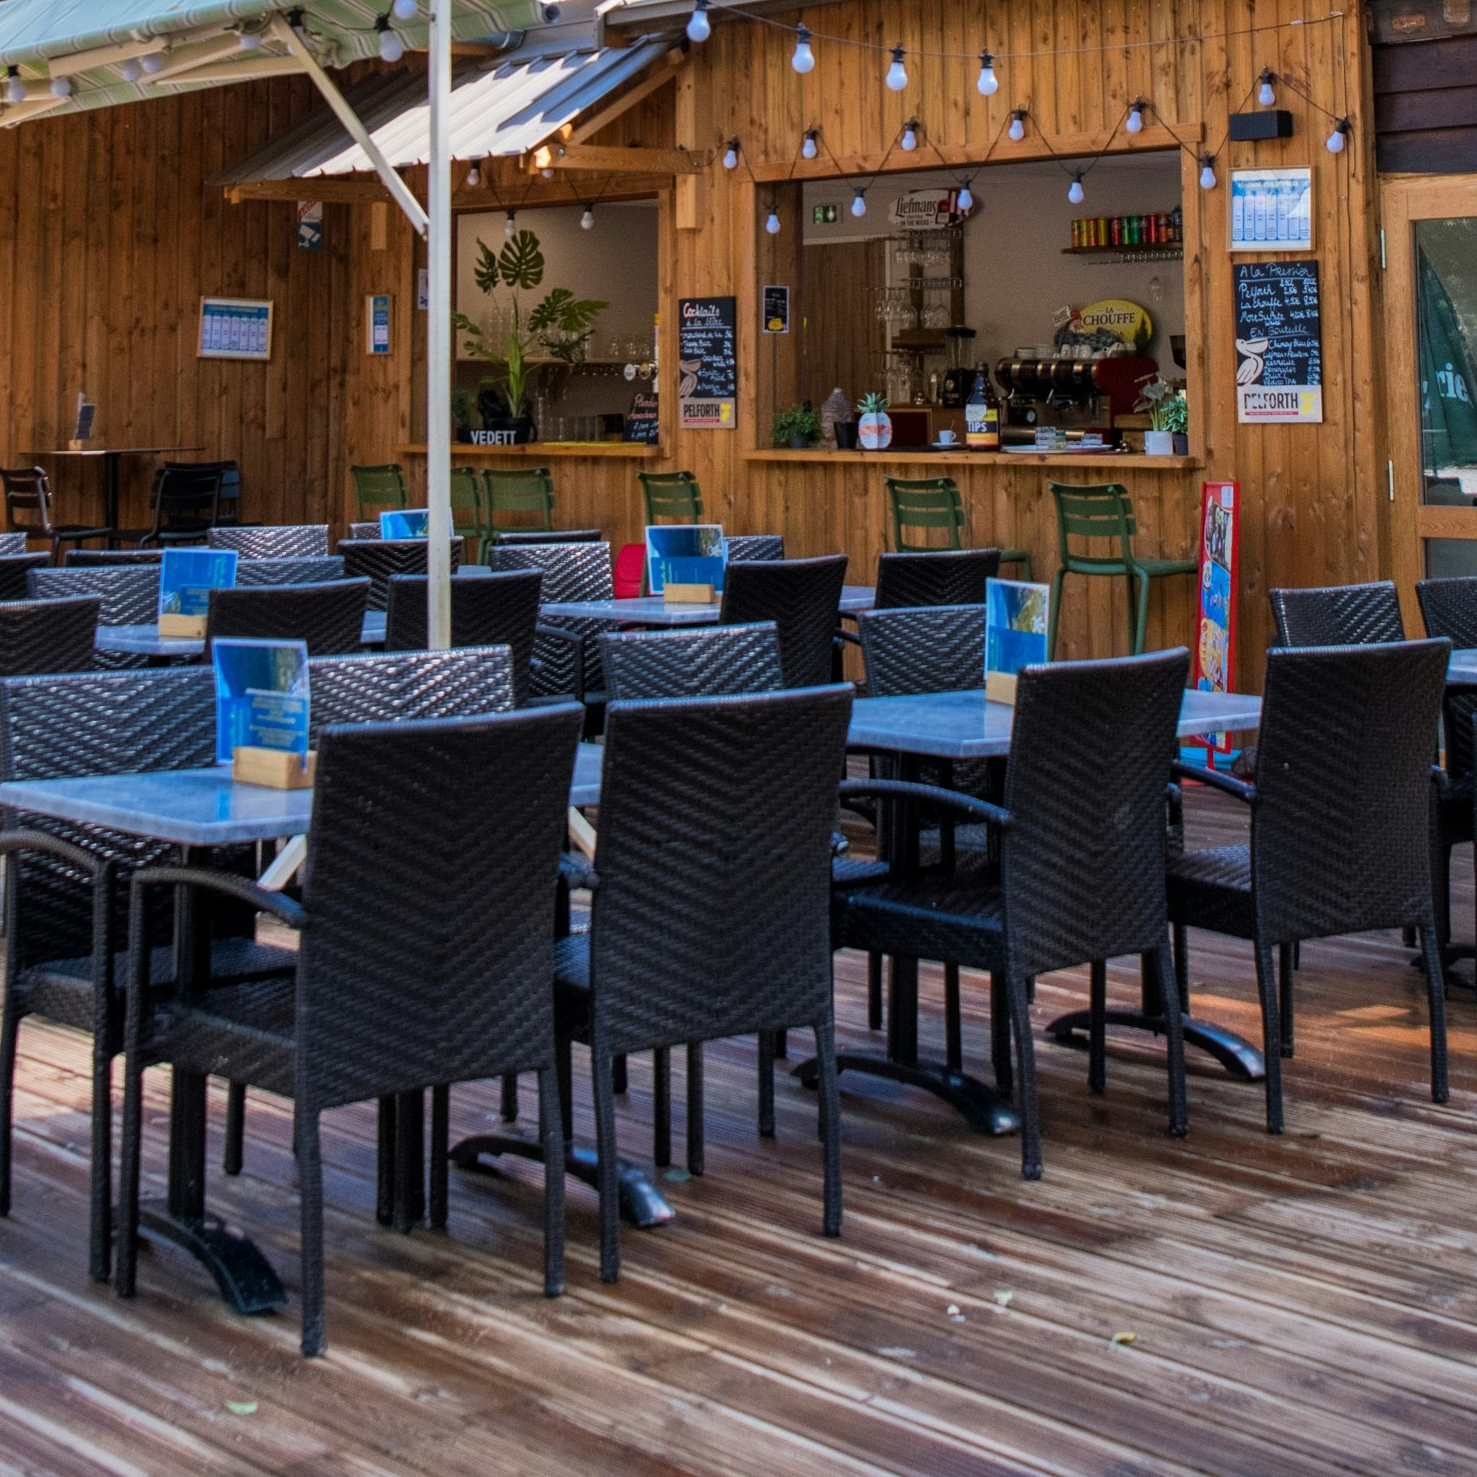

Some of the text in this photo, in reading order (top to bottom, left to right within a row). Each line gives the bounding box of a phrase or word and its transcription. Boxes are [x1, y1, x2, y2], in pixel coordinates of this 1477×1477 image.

[895, 197, 937, 217] Liefmans
[1240, 266, 1248, 277] A
[683, 302, 720, 318] Cocktails
[1083, 312, 1136, 325] CHOUFFE
[1244, 392, 1298, 409] PELFORTH
[684, 404, 720, 417] PELFORTH
[967, 421, 987, 433] TIPS
[470, 430, 517, 445] VEDETT
